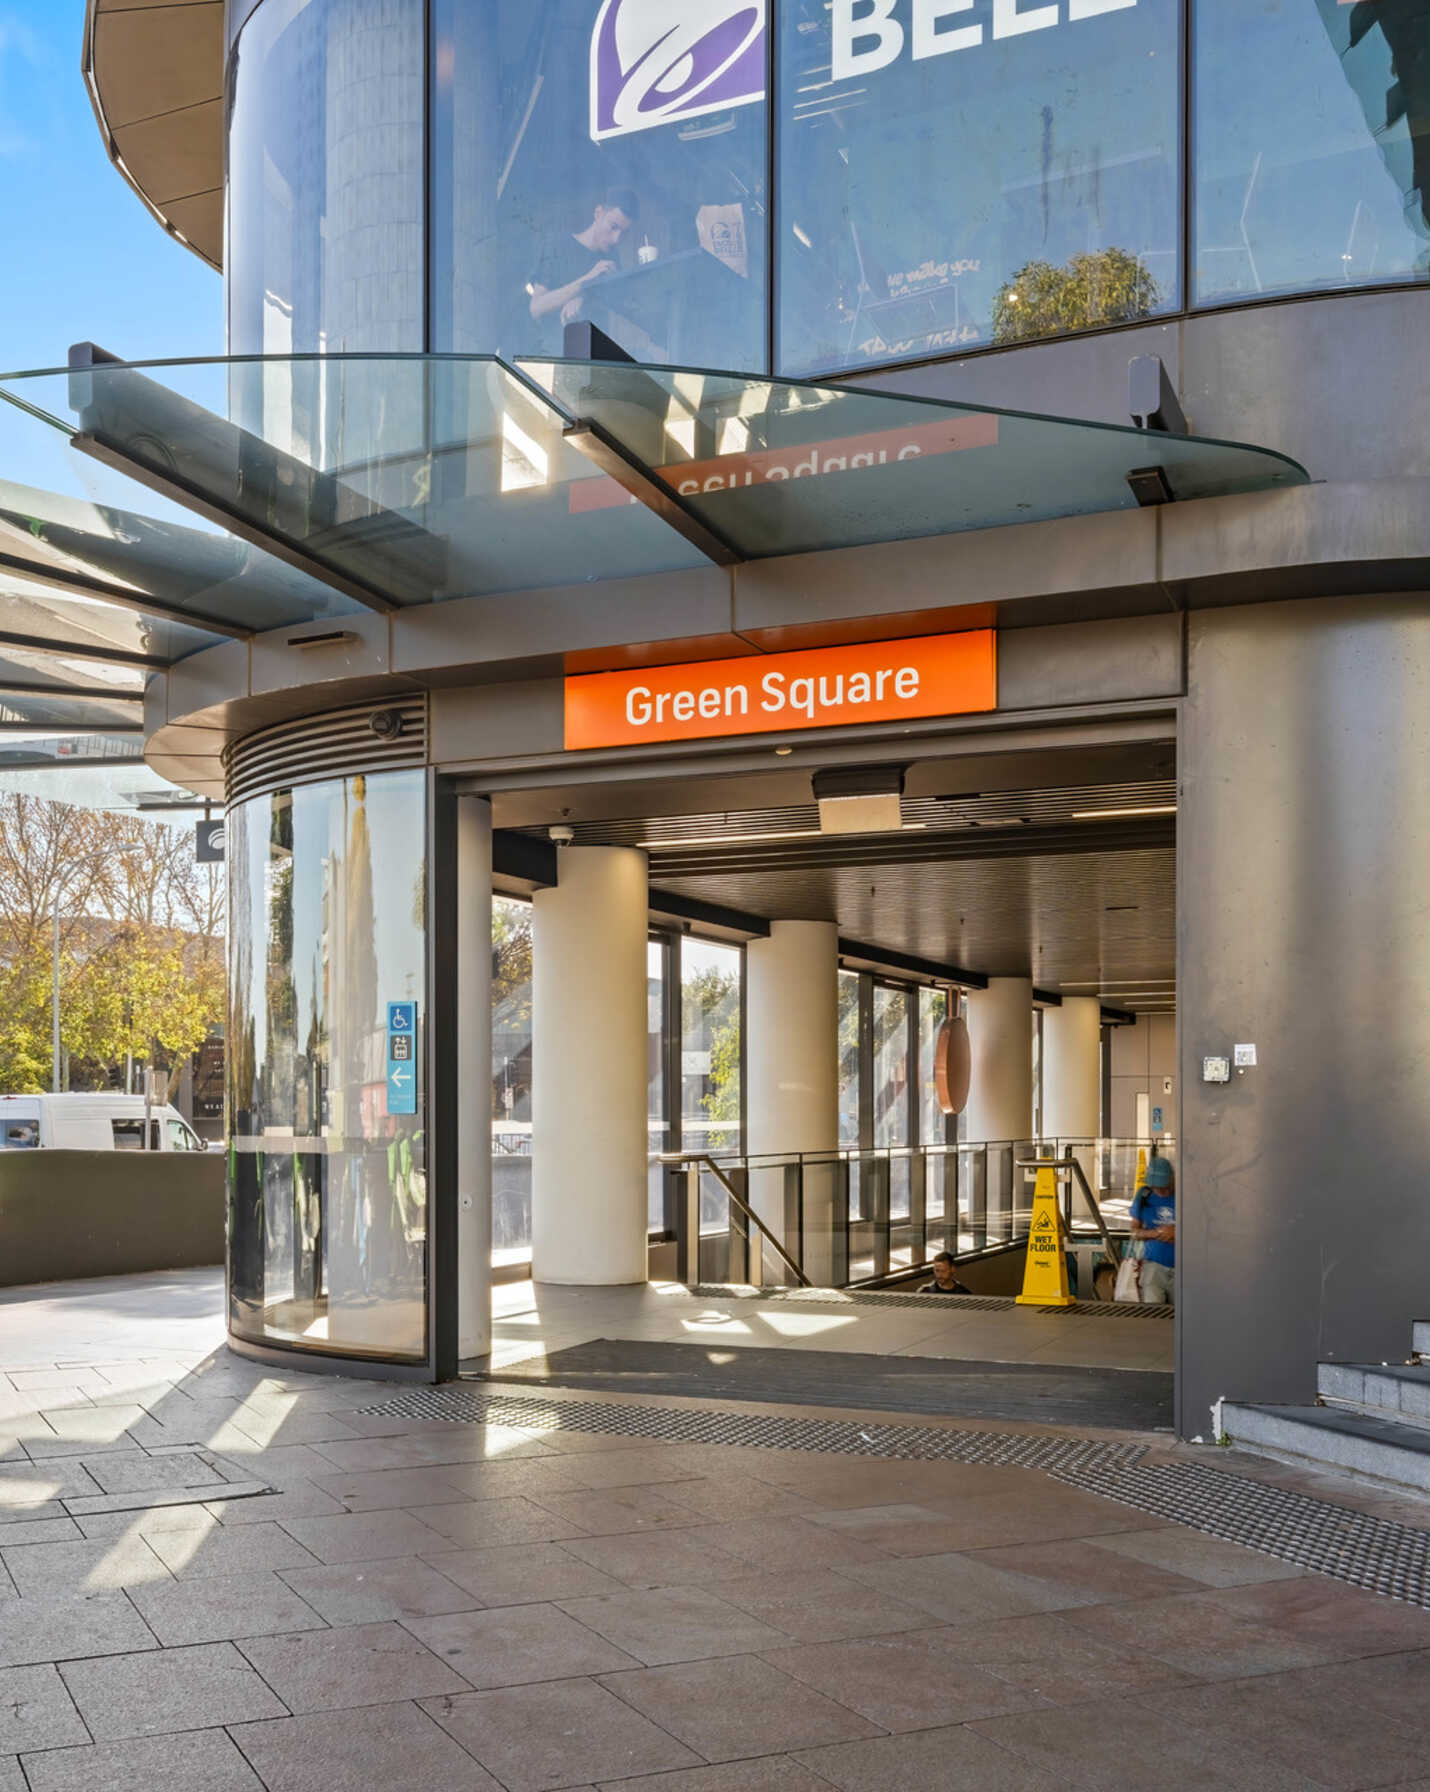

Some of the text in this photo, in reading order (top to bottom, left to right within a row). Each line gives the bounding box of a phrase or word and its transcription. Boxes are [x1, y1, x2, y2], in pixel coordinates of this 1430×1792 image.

[832, 0, 1137, 82] BE
[625, 666, 920, 726] Green Square
[1030, 1243, 1057, 1253] FLOOR
[1034, 1235, 1053, 1244] WET
